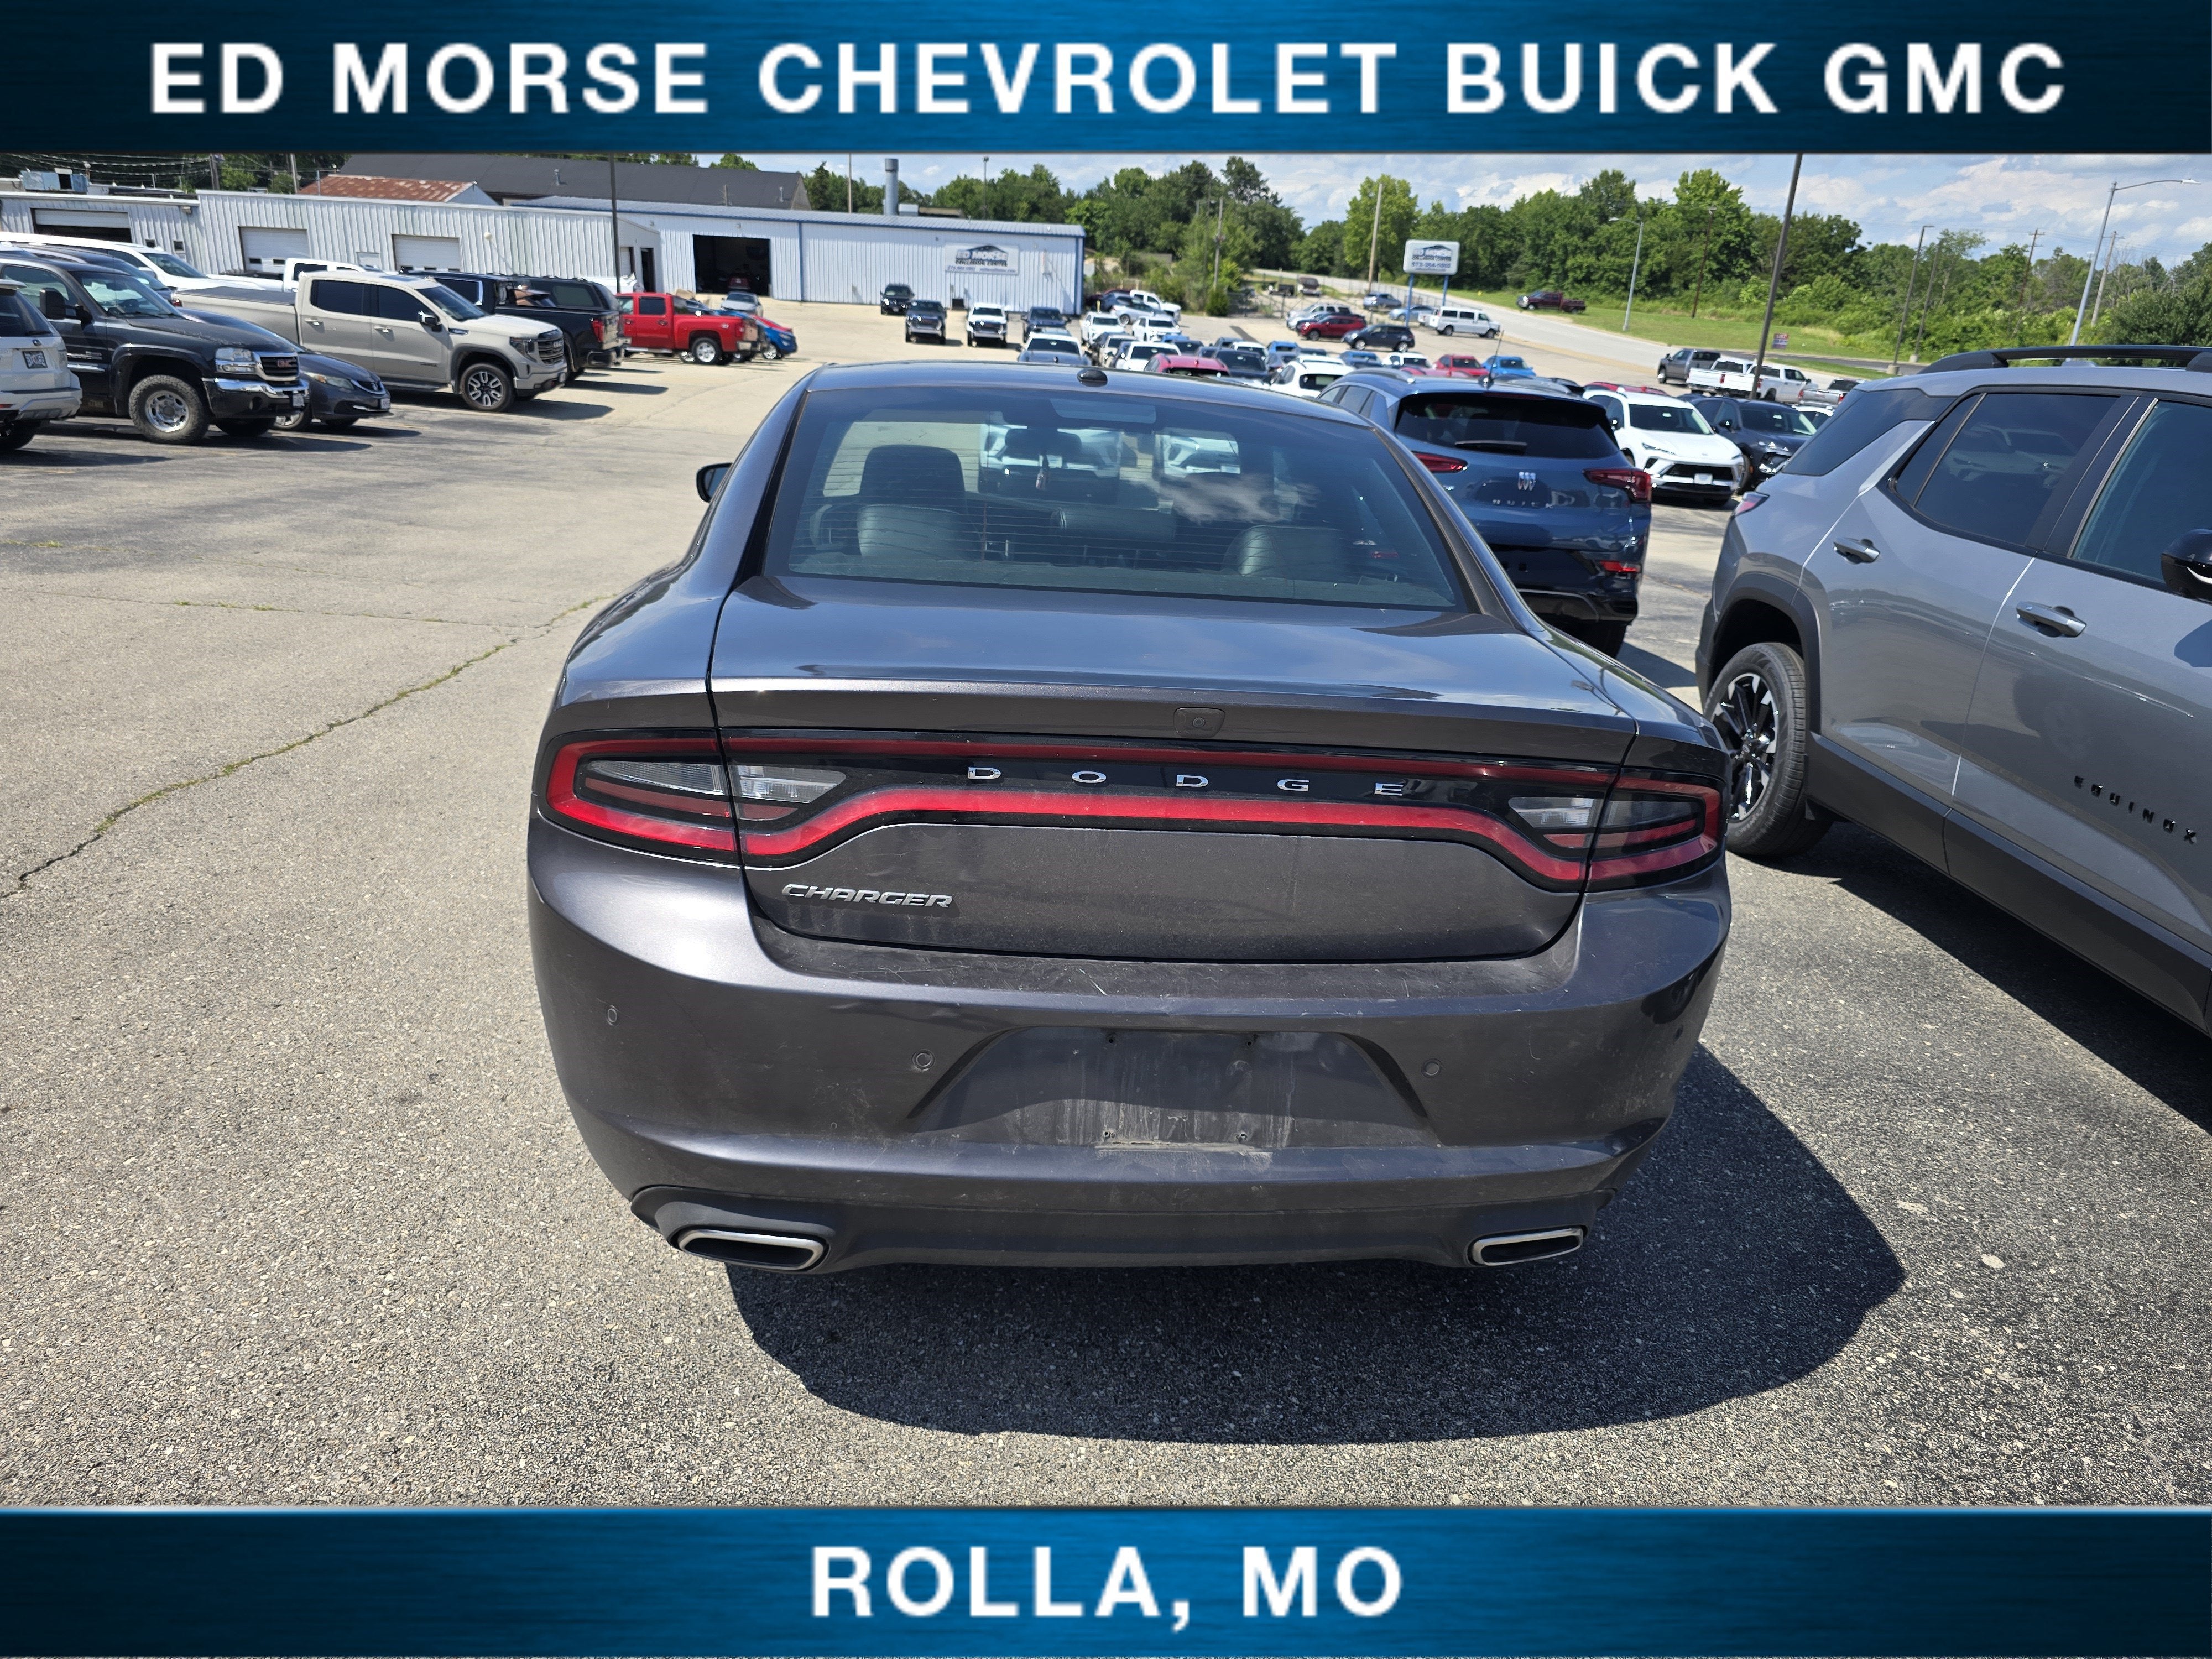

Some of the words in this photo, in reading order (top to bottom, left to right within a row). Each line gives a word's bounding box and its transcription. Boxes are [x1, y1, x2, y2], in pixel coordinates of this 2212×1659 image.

[972, 251, 1008, 261] MORSE
[968, 766, 1404, 796] DODGE
[2074, 775, 2198, 844] EQUINOX
[781, 884, 953, 908] CHARGER
